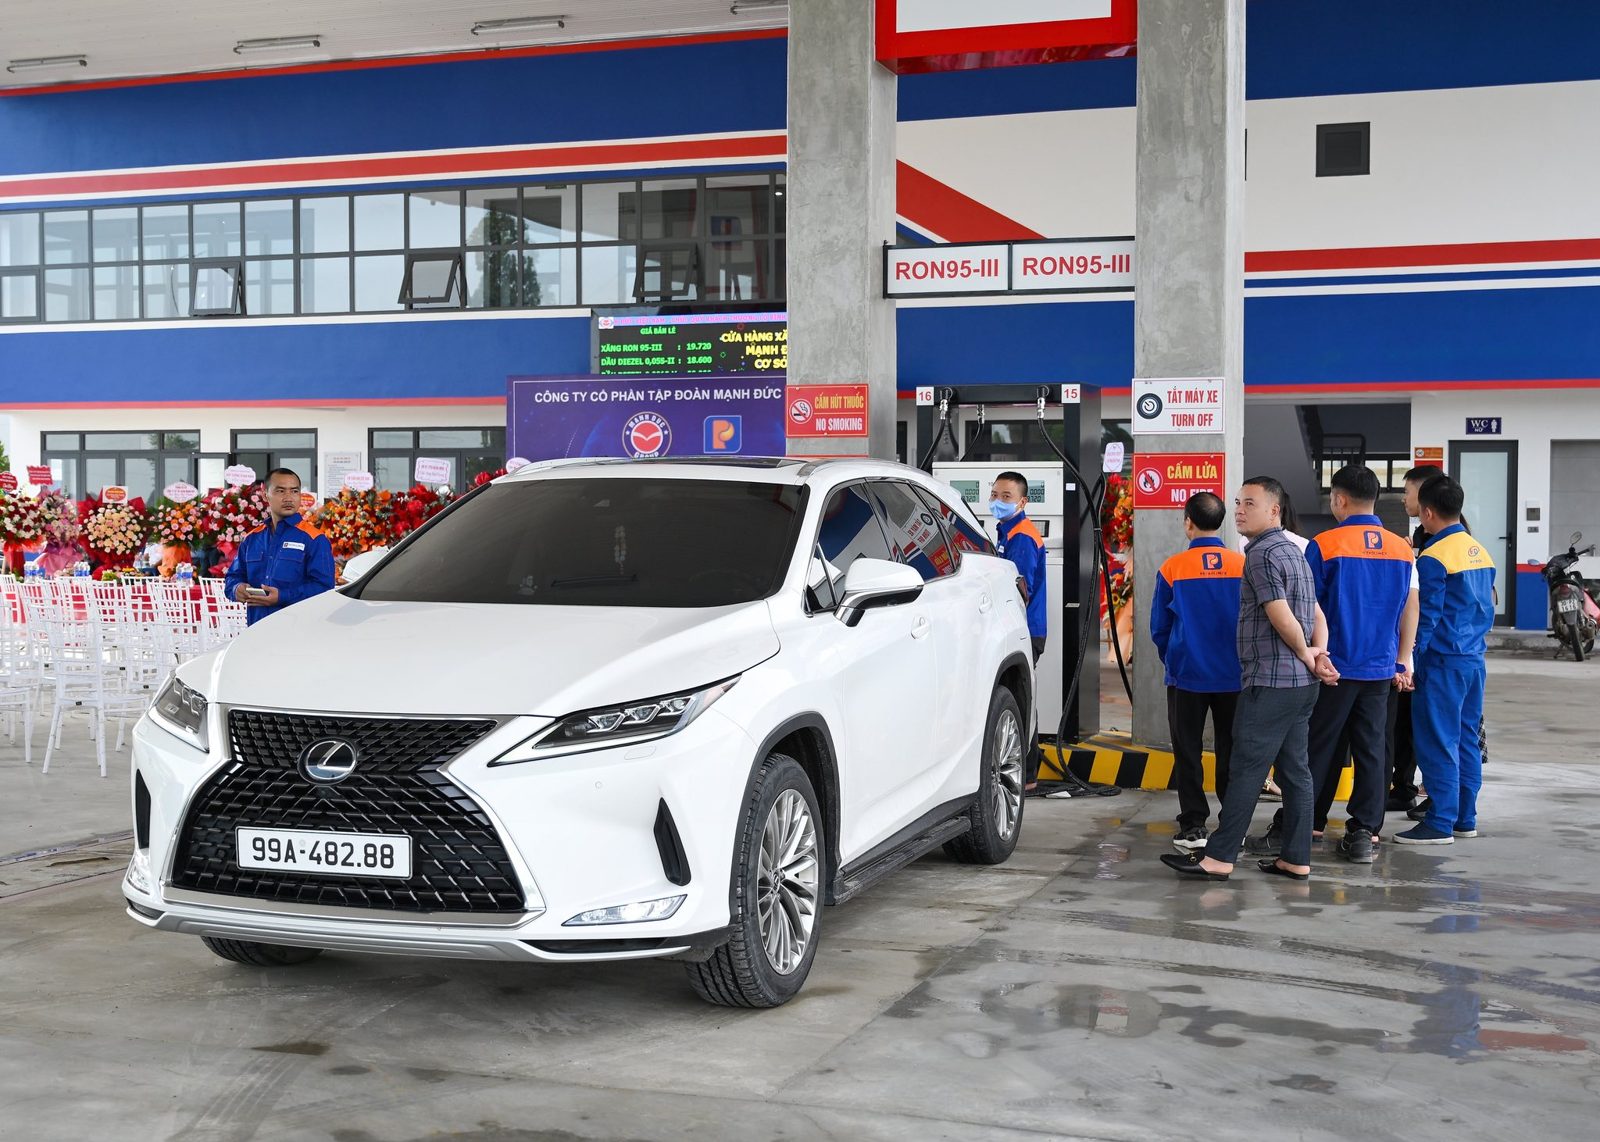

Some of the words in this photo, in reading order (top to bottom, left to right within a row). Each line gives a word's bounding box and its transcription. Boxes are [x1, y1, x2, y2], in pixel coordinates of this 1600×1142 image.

[895, 258, 999, 281] RON95-III
[1022, 254, 1131, 276] RON95-III
[640, 326, 652, 334] GIÁ
[653, 326, 667, 334] BÁN
[720, 330, 742, 343] CỬA
[744, 329, 773, 342] HÀNG
[601, 344, 621, 352] XĂNG
[622, 344, 638, 352] RON
[640, 344, 662, 352] 95-III
[686, 342, 711, 351] 19.720
[745, 345, 778, 357] MẠNH
[617, 357, 644, 366] DIEZEL
[687, 356, 713, 365] 18.600
[534, 389, 568, 403] CÔNG
[572, 391, 586, 403] TY
[648, 388, 672, 403] TẬP
[674, 387, 710, 401] ĐOÀN
[713, 388, 750, 402] MẠNH
[753, 386, 782, 400] ĐỨC
[814, 392, 829, 409] CẤM
[830, 394, 842, 409] HÚT
[843, 392, 864, 409] THUỐC
[918, 390, 932, 402] 16
[1063, 388, 1078, 399] 15
[1167, 386, 1183, 404] TẮT
[1185, 387, 1204, 403] MÁY
[1207, 390, 1218, 403] XE
[815, 418, 826, 431] NO
[827, 417, 863, 431] SMOKING
[1171, 413, 1194, 427] TURN
[1197, 413, 1214, 427] OFF
[1471, 419, 1488, 428] WC
[1167, 461, 1193, 479] CẤM
[1196, 461, 1217, 479] LỬA
[1170, 488, 1187, 503] NO
[251, 836, 395, 869] 99A-482.88
